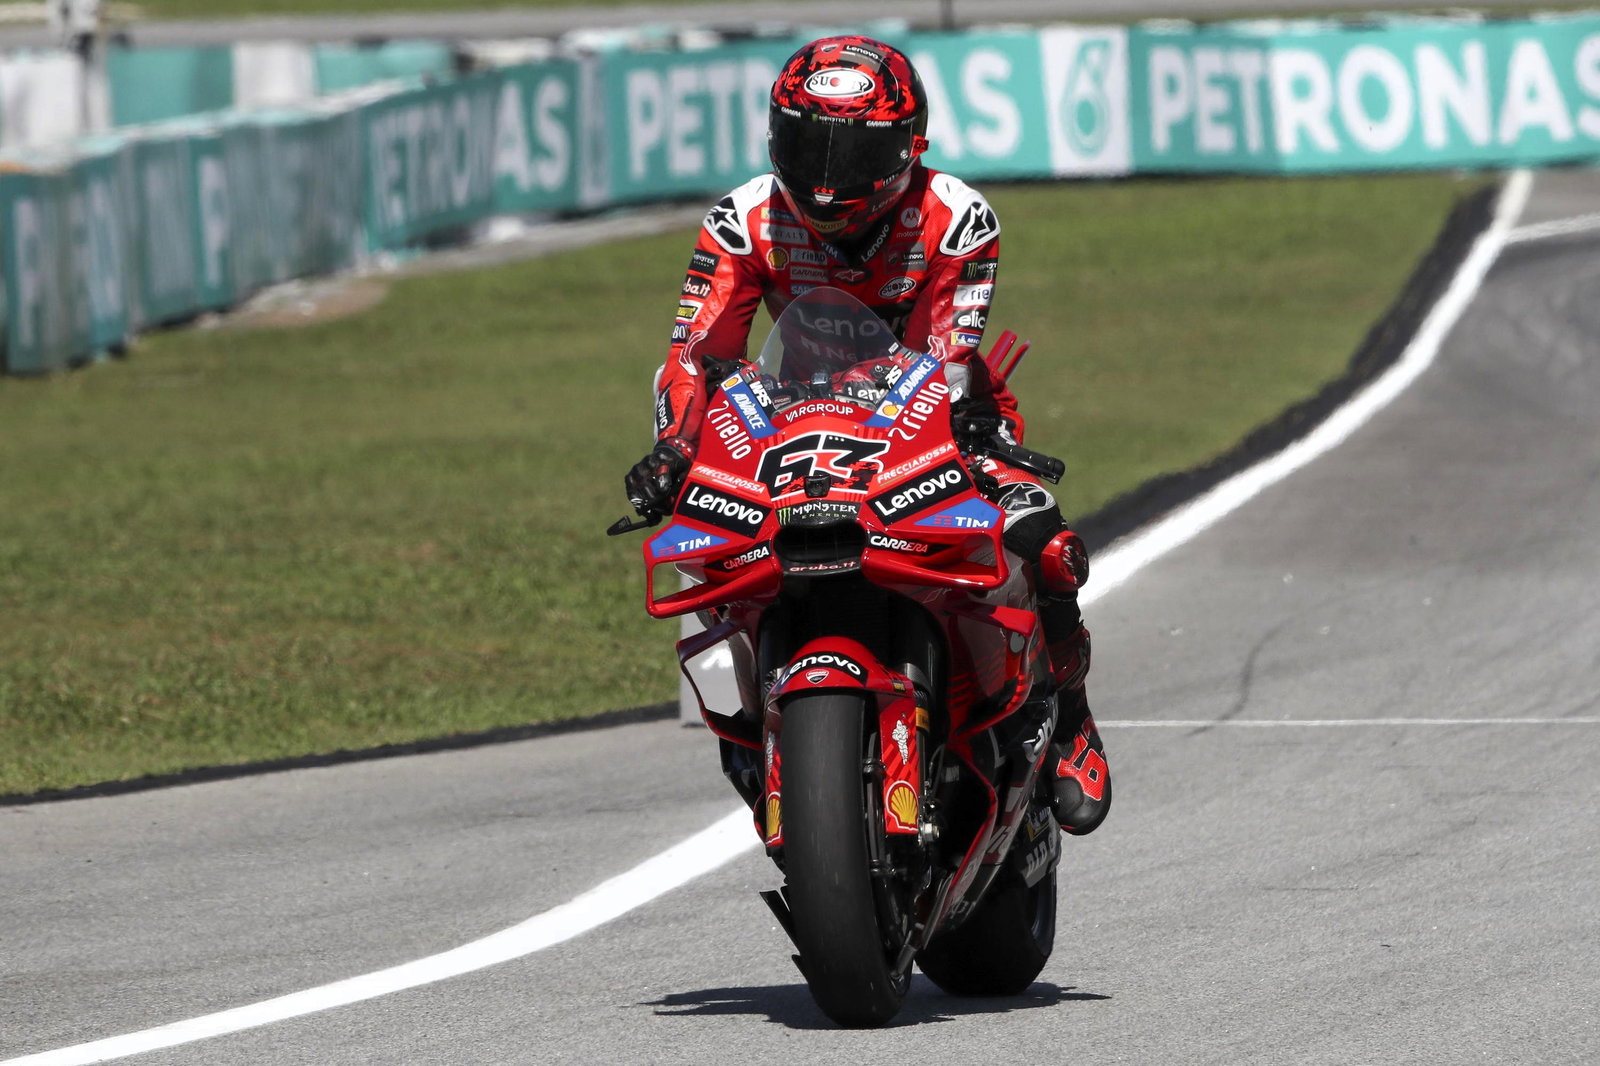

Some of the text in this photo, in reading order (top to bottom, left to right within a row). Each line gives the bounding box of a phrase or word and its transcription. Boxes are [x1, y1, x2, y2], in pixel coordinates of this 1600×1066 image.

[846, 45, 879, 60] Lenovo
[811, 74, 868, 92] SUOY
[624, 50, 1023, 182] PETRAS
[861, 224, 890, 263] Lenovo
[898, 357, 936, 401] ADVANCE
[731, 392, 766, 431] ADVANCE
[785, 403, 854, 423] VARGROUP
[902, 381, 950, 431] riello
[711, 412, 753, 460] riello
[694, 465, 766, 495] FRECCIAROSSA
[754, 430, 891, 501] 63
[876, 443, 955, 484] FRECCIAROSSA
[686, 486, 764, 525] Lenovo
[792, 502, 858, 516] MONSTER
[874, 469, 962, 516] Lenovo
[954, 516, 990, 528] TIM
[677, 535, 711, 552] TIM
[723, 546, 770, 570] CARRERA
[870, 535, 928, 553] CARRERA
